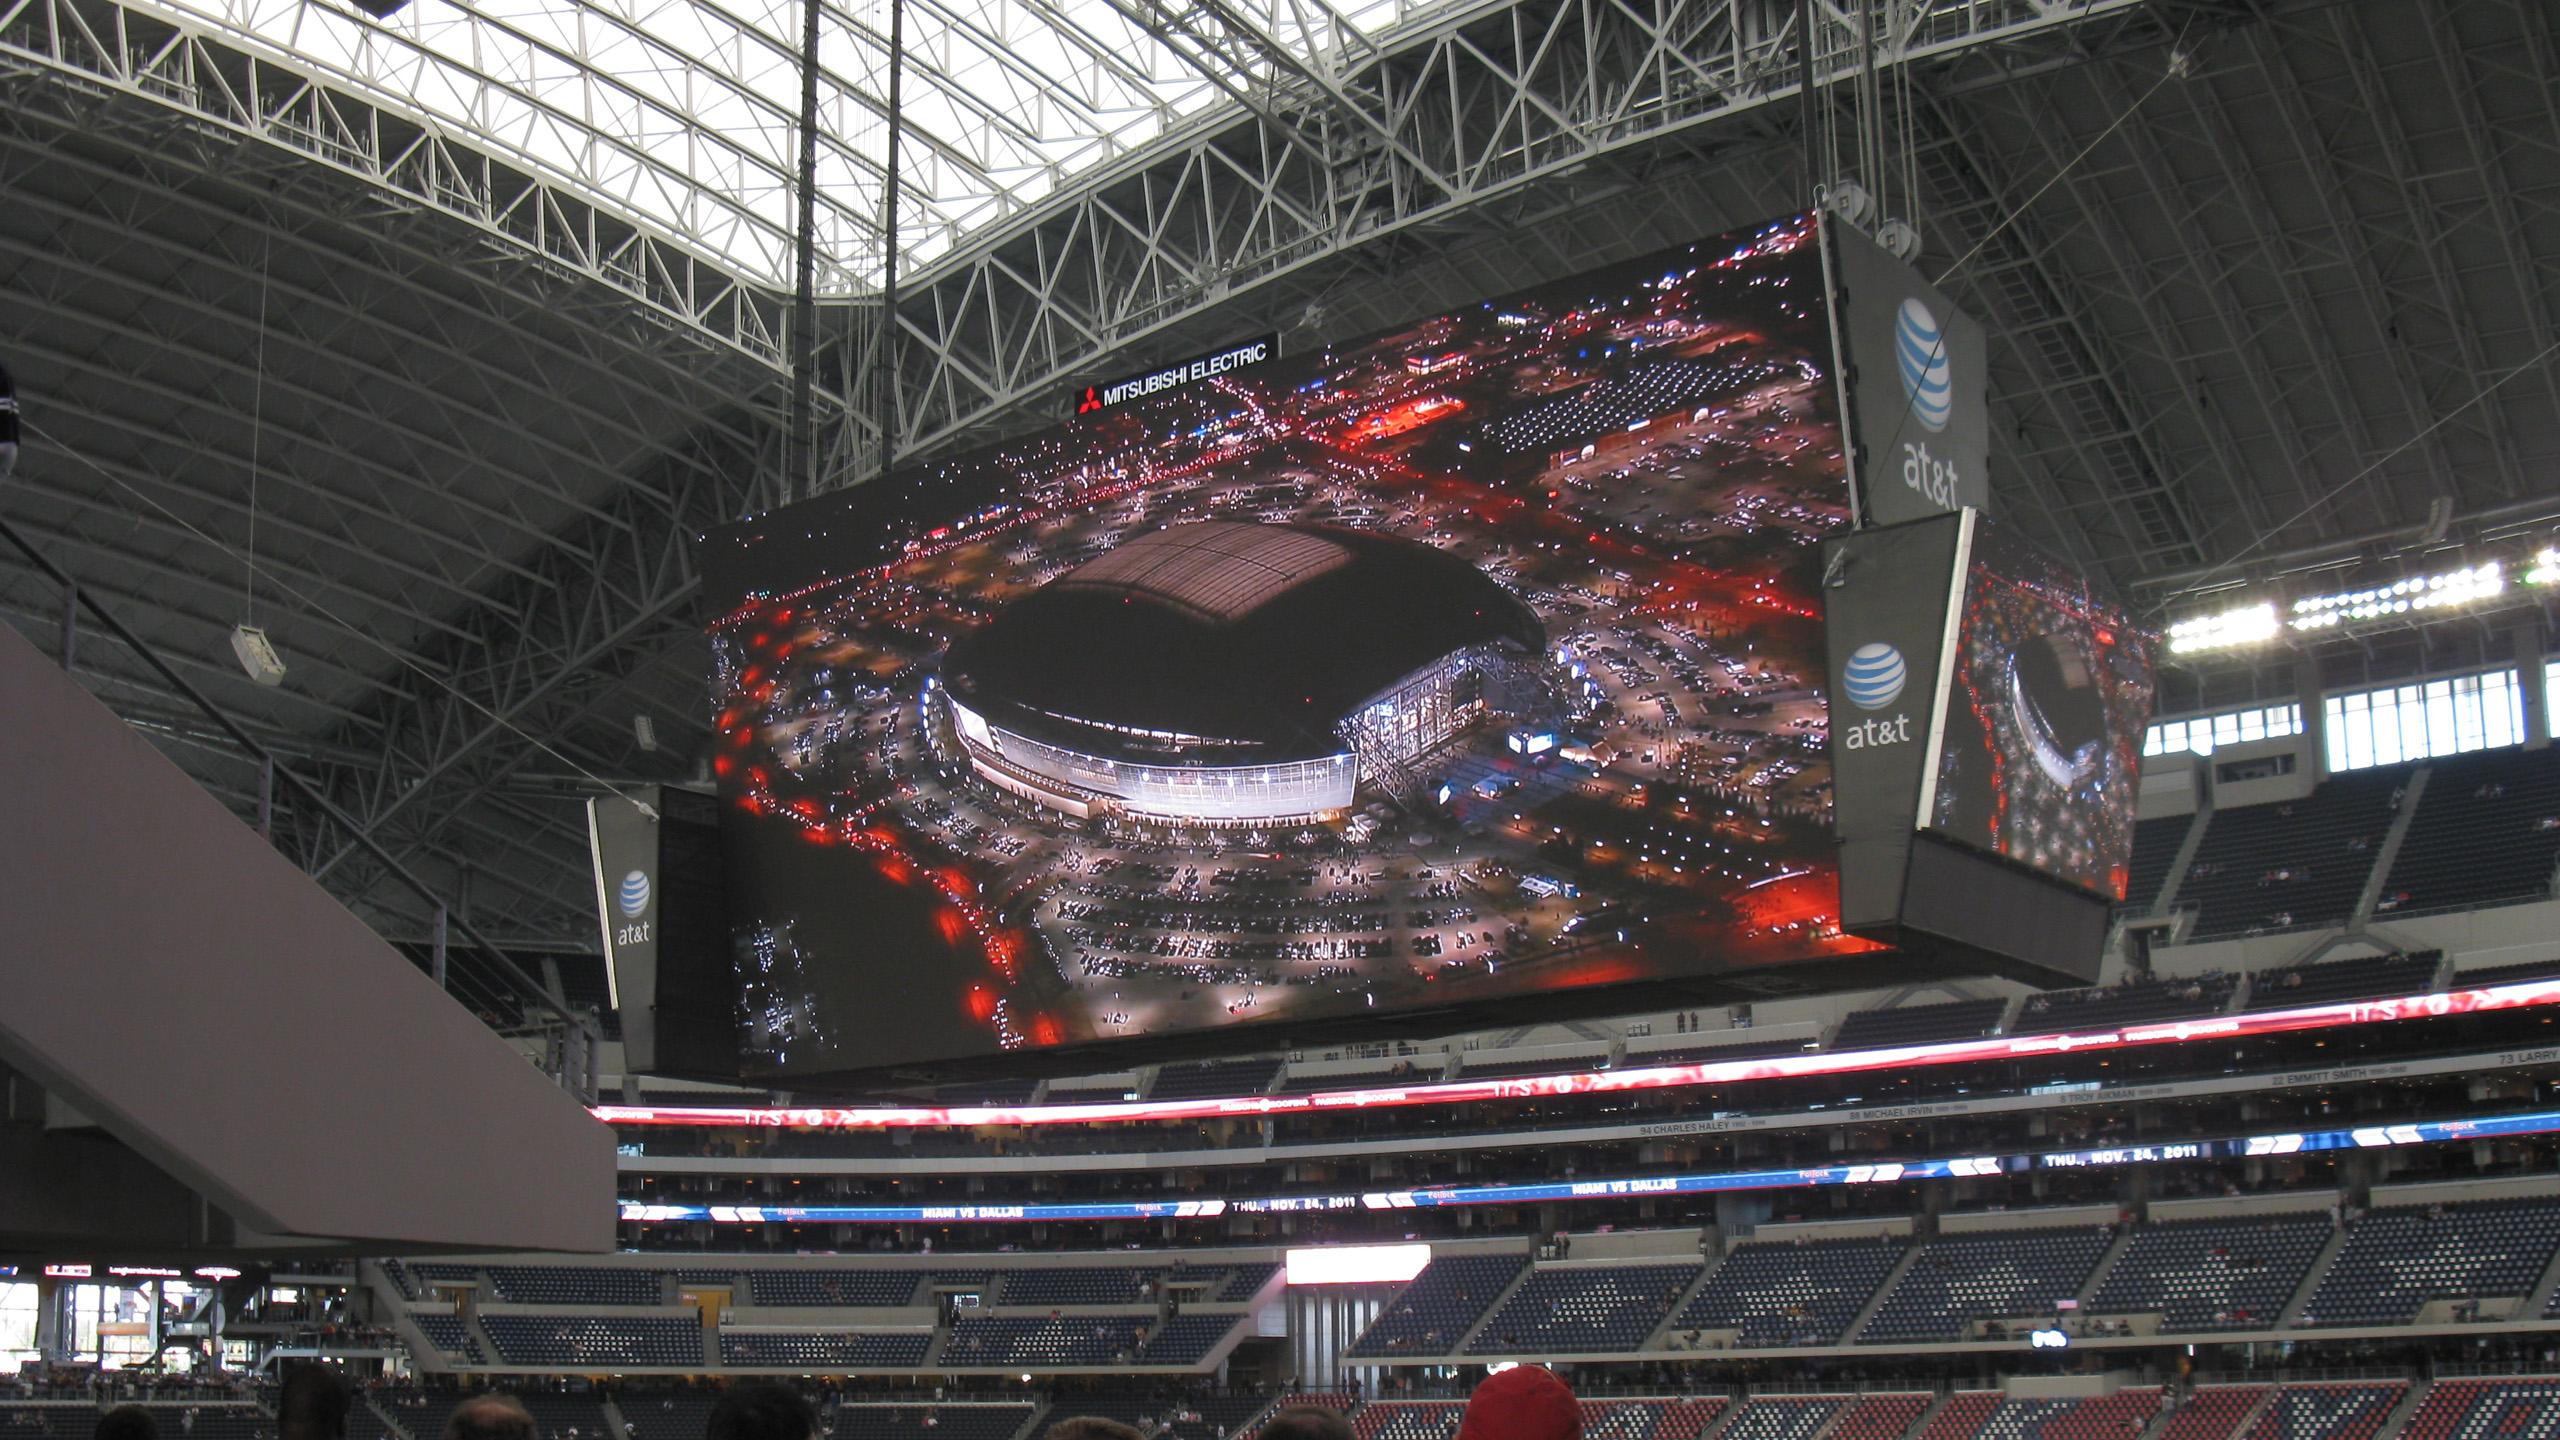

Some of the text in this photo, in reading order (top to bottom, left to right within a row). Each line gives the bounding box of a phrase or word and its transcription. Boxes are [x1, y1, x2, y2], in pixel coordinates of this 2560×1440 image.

[1104, 343, 1266, 406] MITSUBISHI ELECTRIC
[1904, 441, 1958, 511] at&t
[1845, 712, 1910, 750] at&t
[618, 921, 649, 946] at&t
[2499, 1050, 2557, 1065] 73 LARRY
[2287, 1071, 2329, 1084] EMMITT
[2333, 1068, 2367, 1080] SMITH
[1863, 1108, 1905, 1119] MICHAEL
[1907, 1105, 1933, 1116] IRVIN
[1640, 1125, 1652, 1135] 94
[1653, 1123, 1698, 1134] CHARLES
[1699, 1120, 1730, 1131] HALEY
[2091, 1150, 2129, 1166] NOV.
[2164, 1145, 2197, 1160] 2011
[1572, 1178, 1677, 1196] MIAMI VS DALLAS
[923, 1206, 1024, 1219] MIAMI VS DALLAS
[1271, 1200, 1298, 1211] NOV.
[1328, 1197, 1355, 1209] 2011
